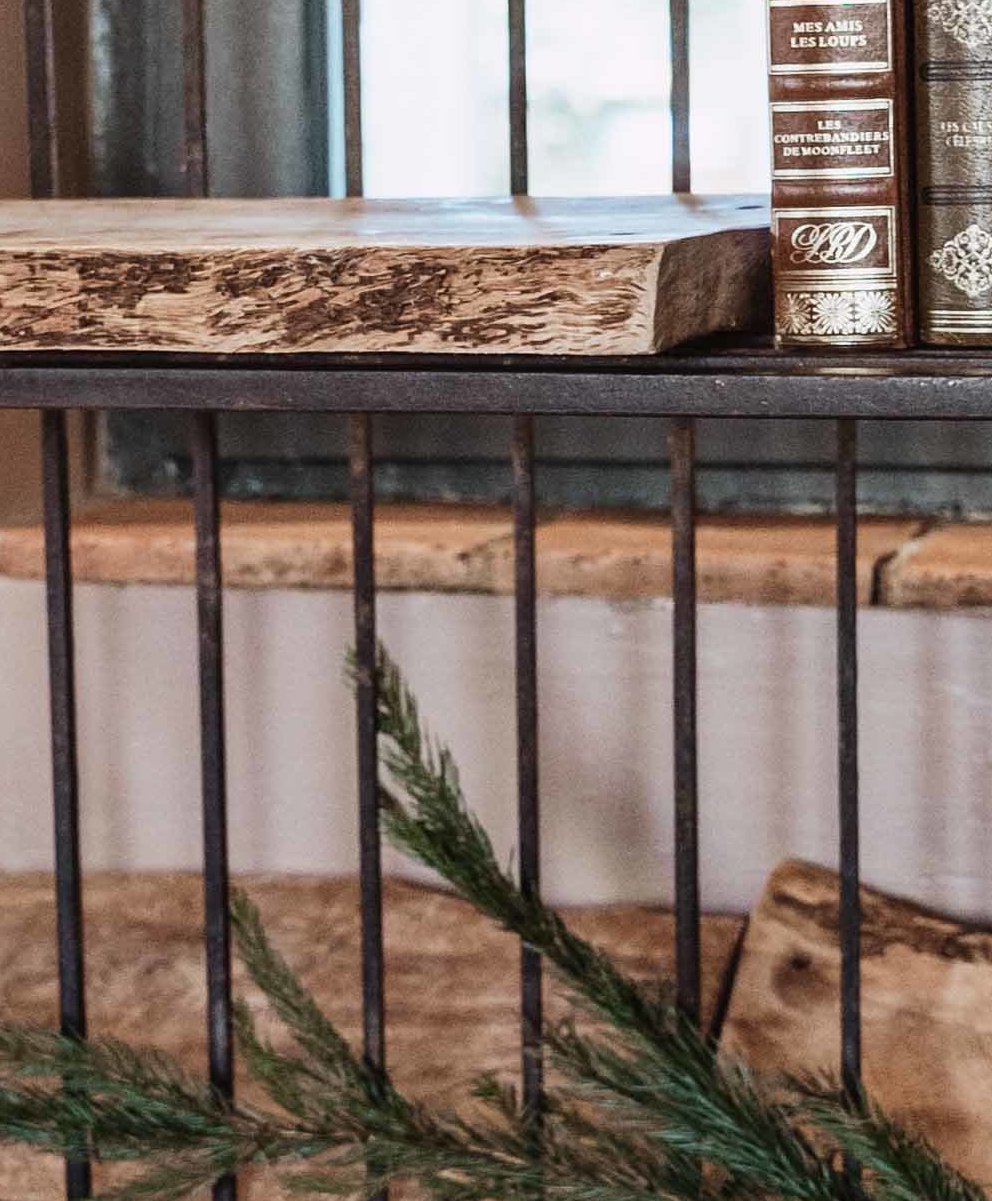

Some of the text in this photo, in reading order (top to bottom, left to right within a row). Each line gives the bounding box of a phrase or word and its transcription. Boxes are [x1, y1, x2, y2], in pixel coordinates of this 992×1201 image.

[793, 20, 864, 33] MES AMIS
[790, 35, 867, 48] LES LOUPS
[817, 120, 841, 130] LES
[774, 131, 889, 144] CONTREBANDIERS
